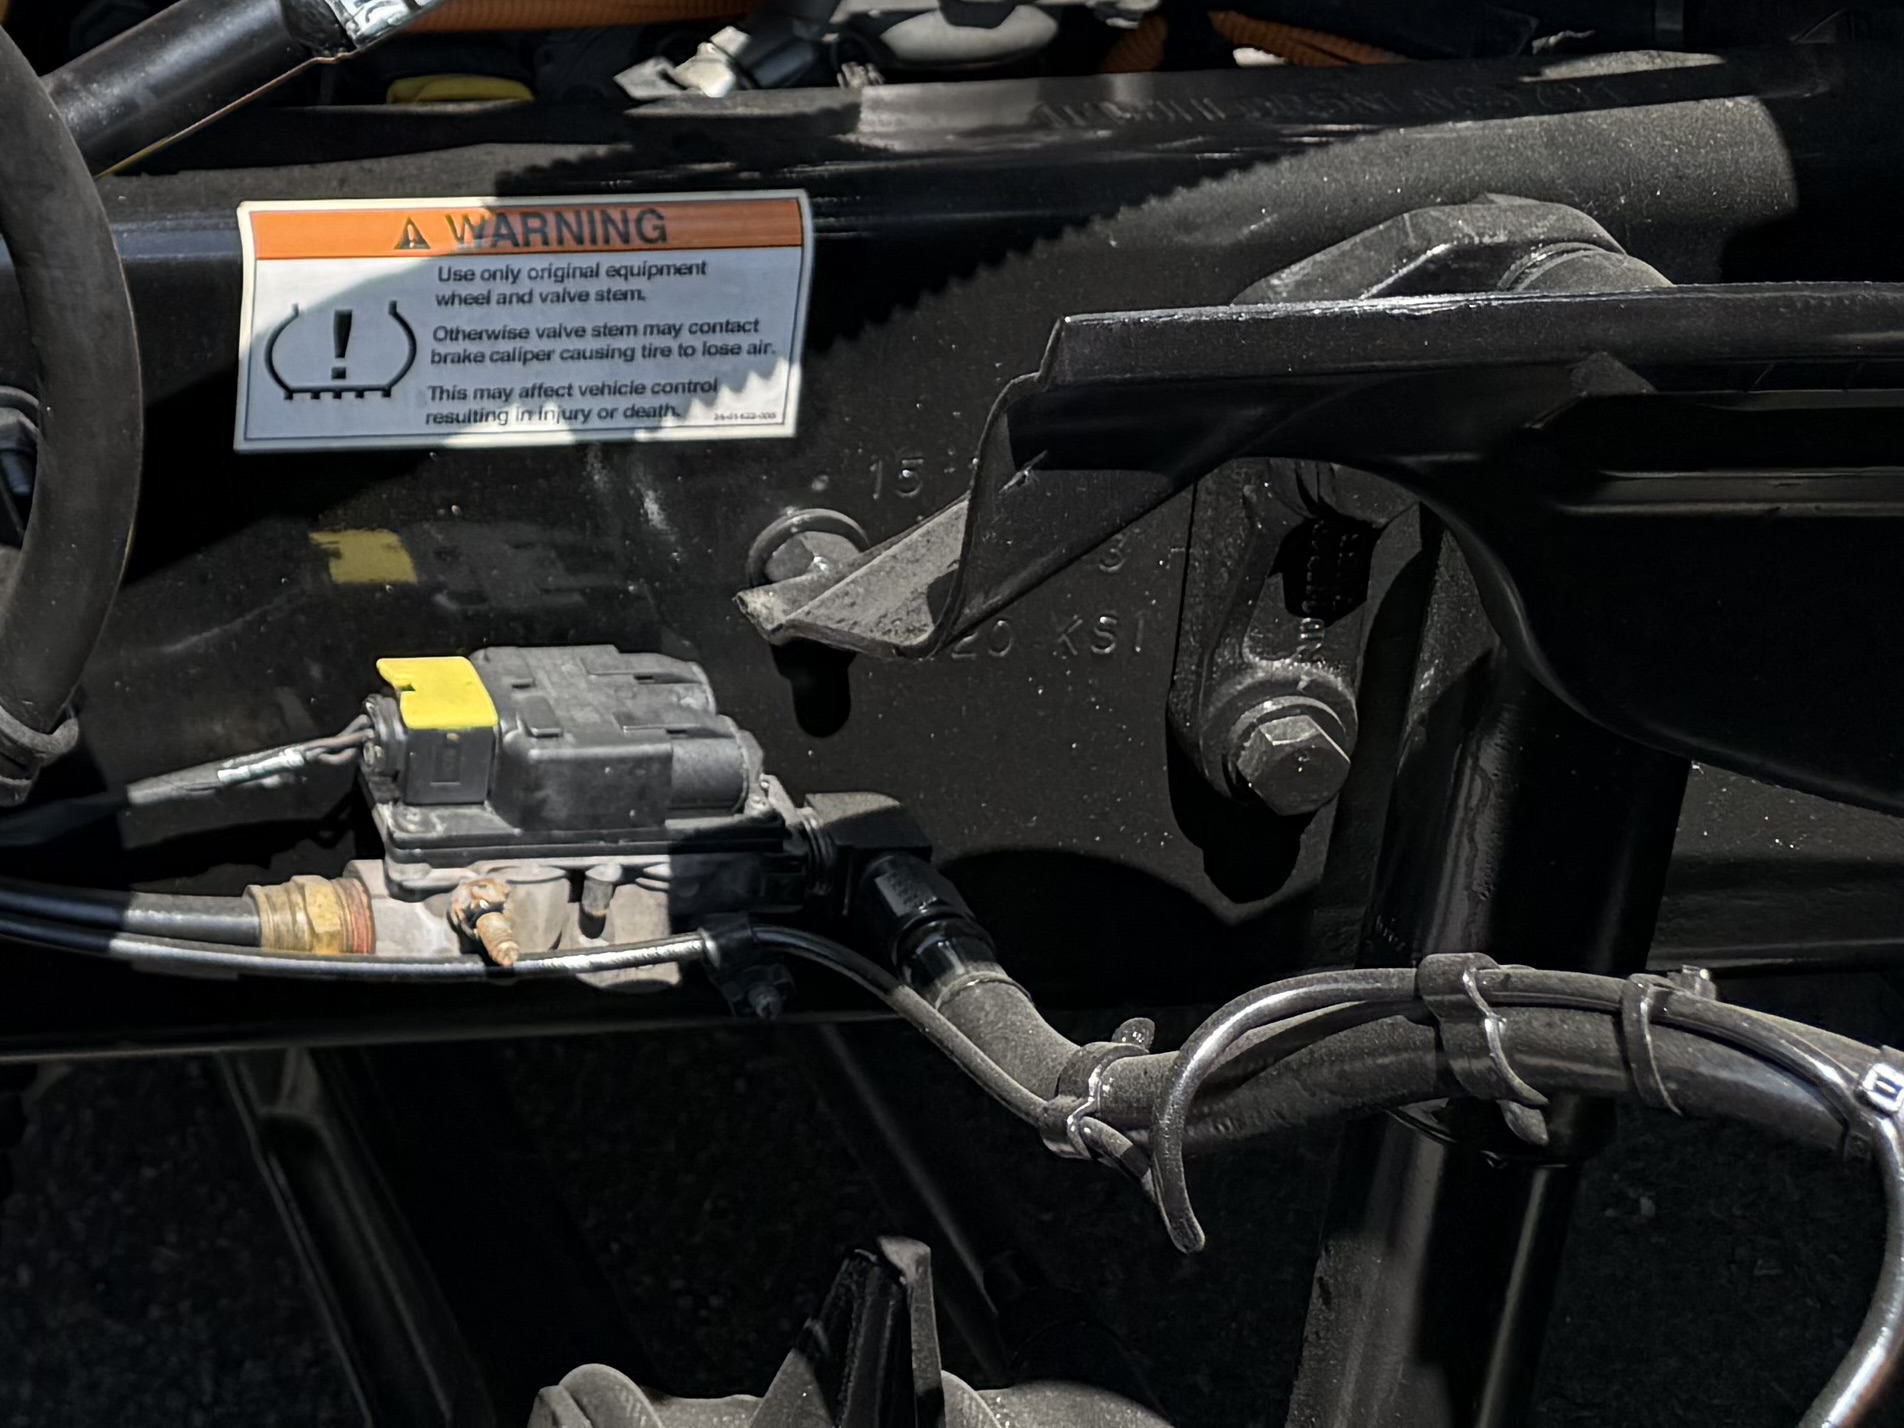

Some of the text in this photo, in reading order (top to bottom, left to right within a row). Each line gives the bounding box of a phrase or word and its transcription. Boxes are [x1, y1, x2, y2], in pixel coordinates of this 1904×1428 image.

[444, 207, 667, 250] WARNING
[437, 258, 708, 287] Use only original equipment
[435, 285, 646, 307] wheel and valve stem.
[433, 316, 760, 344] Otherwise valve stem may contact
[430, 338, 776, 368] brake caliper causing tire to lose air.
[427, 377, 718, 405] This may affect vehicle control
[425, 401, 680, 428] resulting in injury or death.
[1055, 612, 1146, 658] KSI
